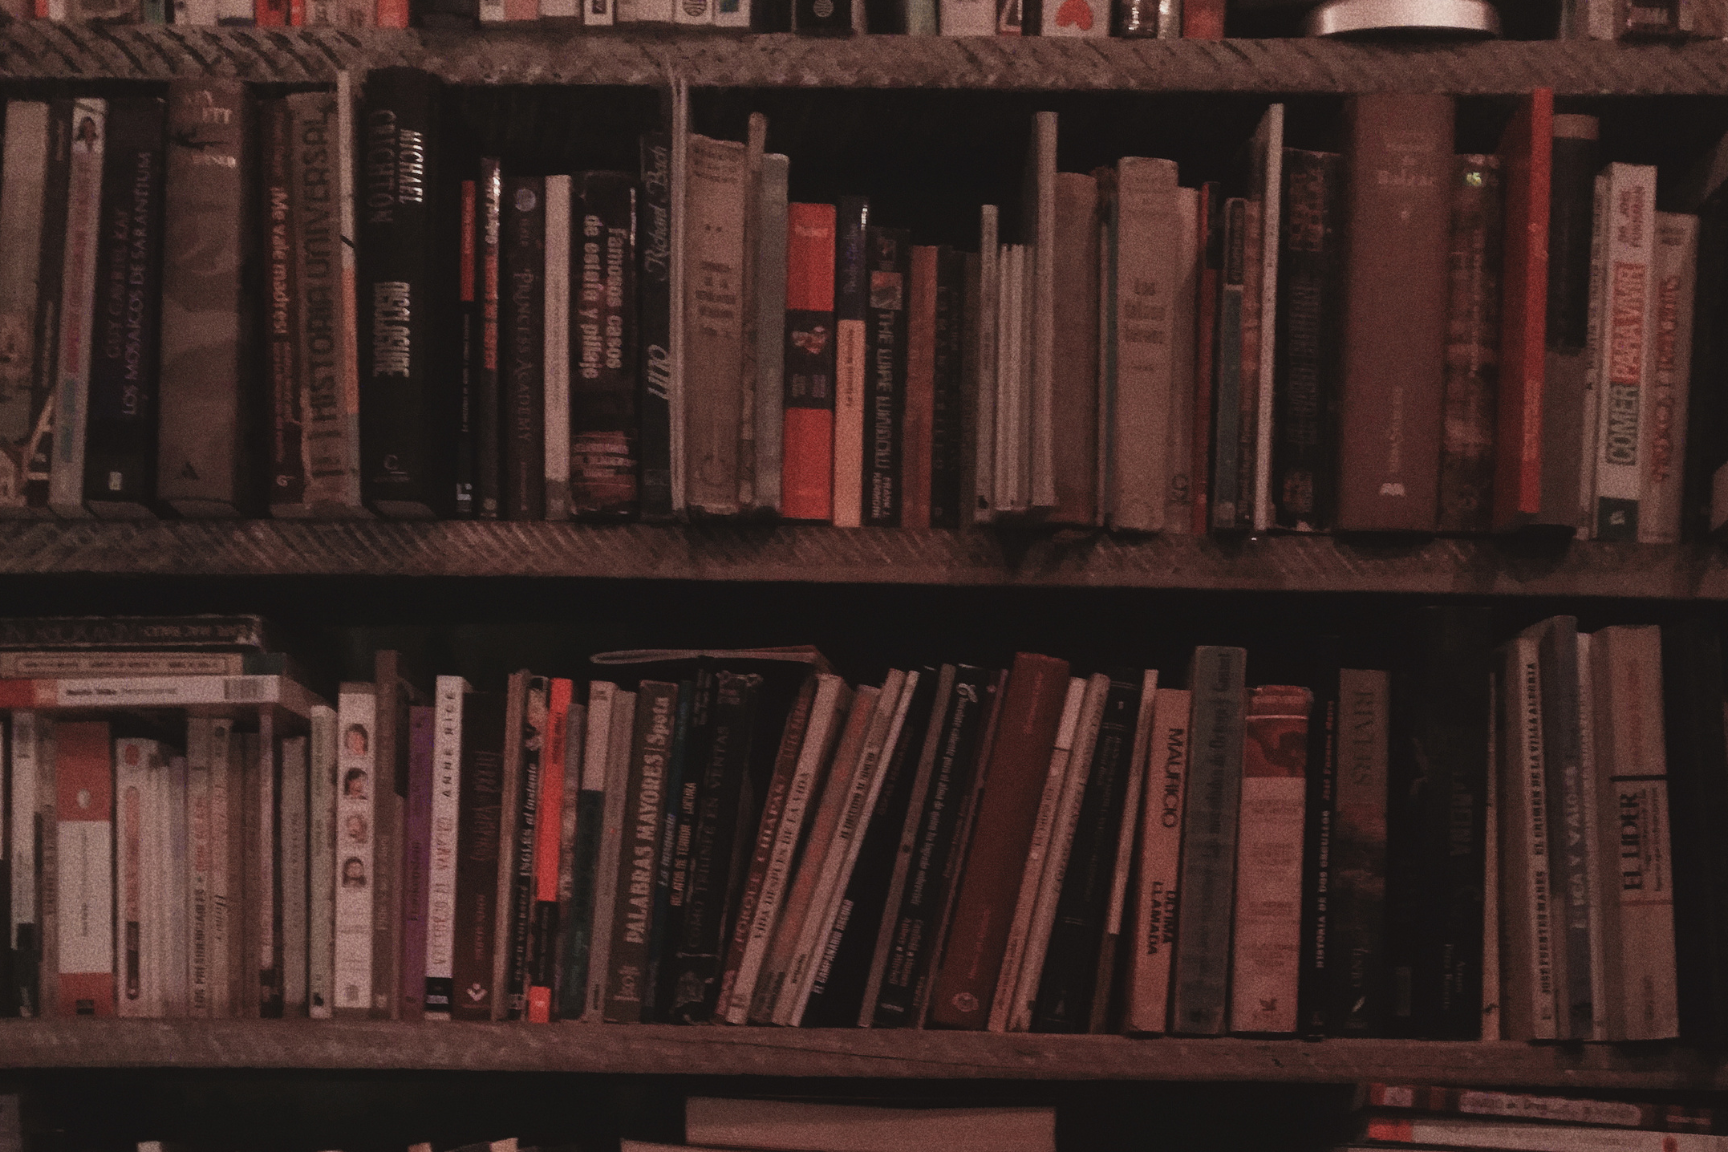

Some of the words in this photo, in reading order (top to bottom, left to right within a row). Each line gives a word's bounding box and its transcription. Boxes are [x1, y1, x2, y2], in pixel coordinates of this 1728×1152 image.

[369, 110, 397, 224] CRICHTON
[400, 129, 424, 205] MICHAEL
[585, 215, 602, 237] de
[373, 281, 411, 378] DISCLOSURE
[606, 316, 623, 369] casos
[879, 313, 895, 343] THE
[636, 755, 664, 842] MAYORES
[1161, 728, 1184, 828] MAURICIO
[625, 847, 654, 944] PALABRAS
